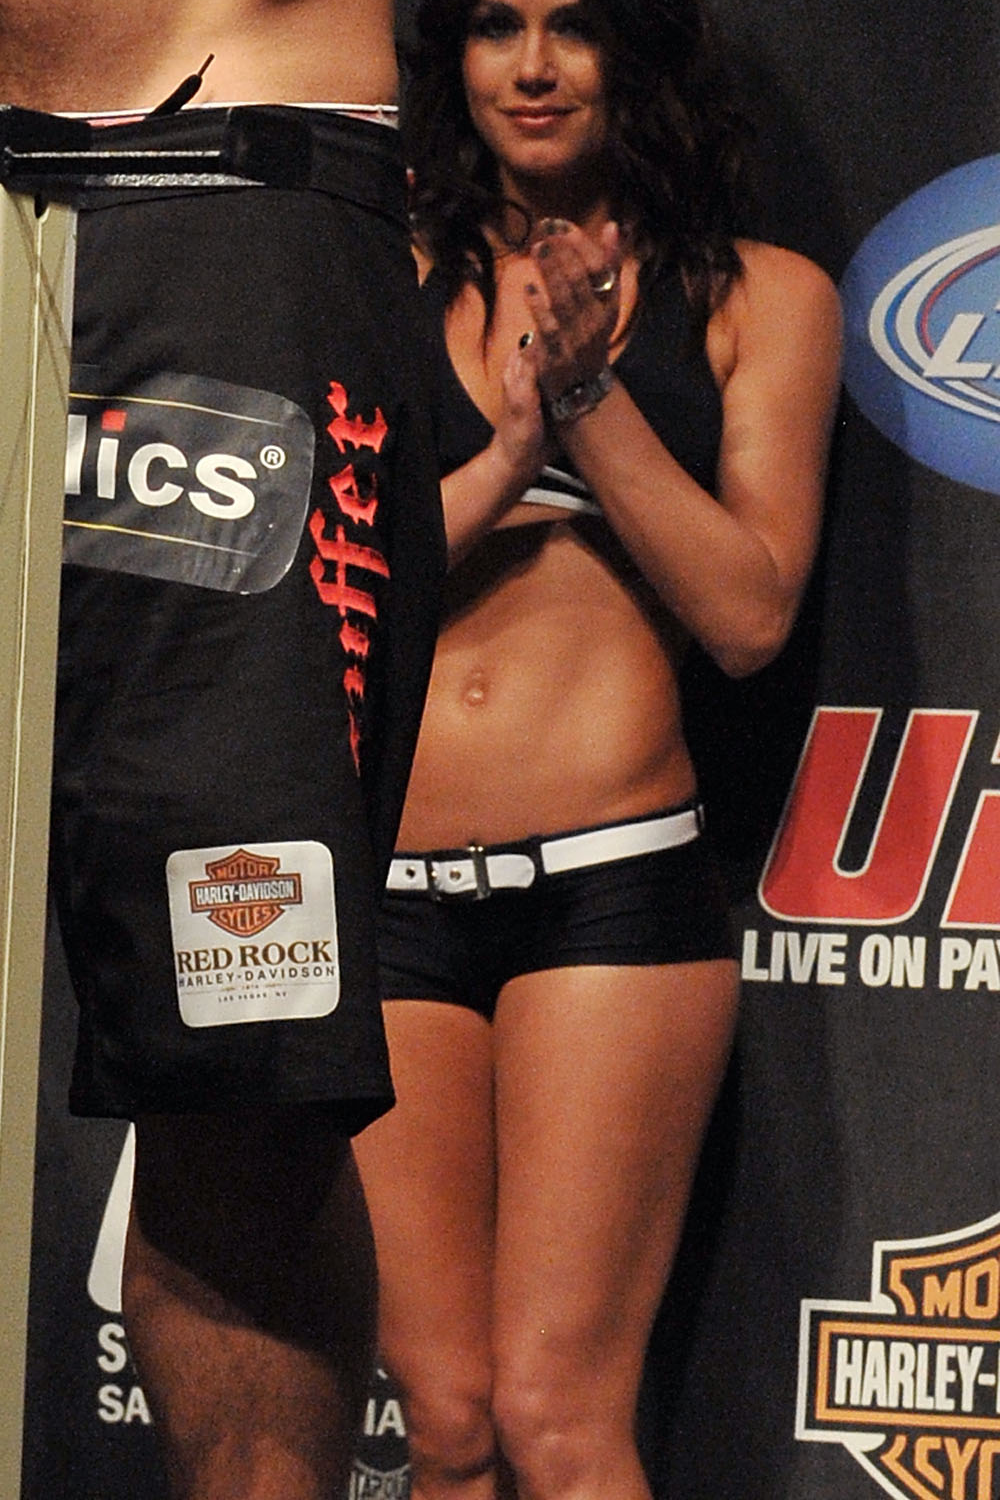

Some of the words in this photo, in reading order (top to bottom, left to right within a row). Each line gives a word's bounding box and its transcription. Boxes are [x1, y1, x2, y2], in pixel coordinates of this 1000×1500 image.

[215, 861, 270, 879] MOTOR
[195, 880, 294, 906] HARLEY-DAVIDSON
[218, 907, 272, 930] CYCLES
[177, 948, 233, 974] RED
[239, 940, 333, 968] ROCK
[742, 930, 848, 985] LIVE
[859, 933, 926, 988] ON
[939, 937, 1000, 991] PA
[178, 967, 335, 988] HARLEY-DAVIDSON
[922, 1257, 1000, 1319] MO
[835, 1339, 996, 1413] HARLEY-
